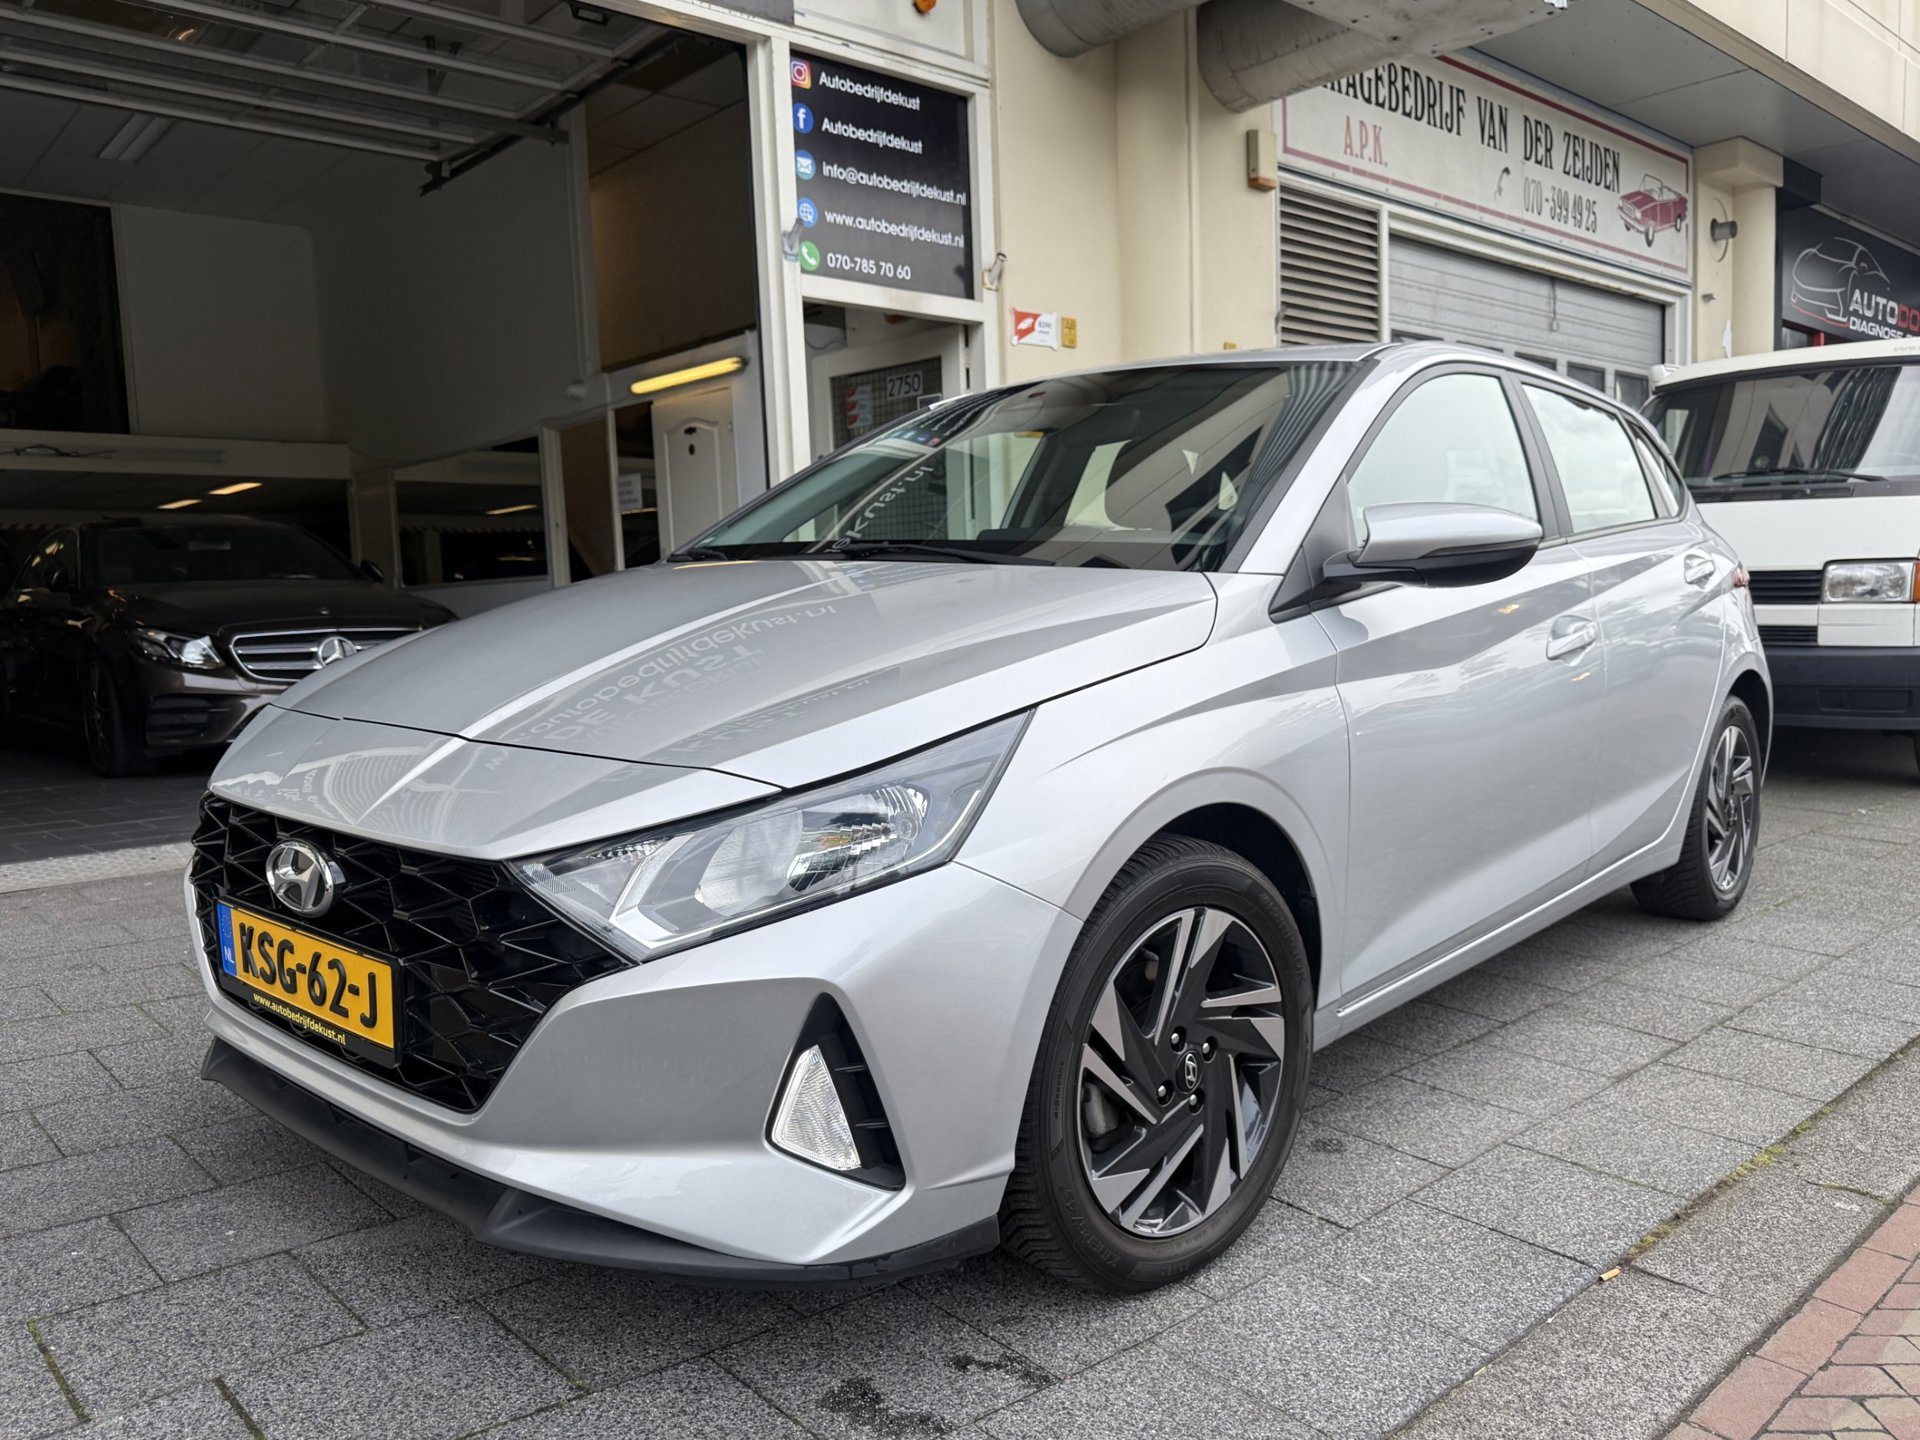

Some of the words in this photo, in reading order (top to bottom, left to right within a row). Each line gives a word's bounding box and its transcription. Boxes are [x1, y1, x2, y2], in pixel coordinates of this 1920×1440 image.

[818, 71, 920, 111] Autobedrijfdekust
[821, 117, 923, 154] Autobedrijfdekust
[1343, 115, 1388, 167] A.P.K.
[1477, 96, 1508, 154] VAN
[1523, 114, 1554, 170] DER
[1563, 131, 1620, 194] ZEIJDEN
[822, 161, 967, 206] info@autobedrijfdekust.nl
[824, 209, 965, 248] www.autobedrijfdekust.nl
[827, 252, 877, 275] 070-785
[879, 261, 895, 278] 70
[896, 264, 911, 280] 60
[1849, 289, 1920, 332] AUTODO
[888, 373, 921, 397] 2750
[224, 946, 235, 964] NL
[239, 922, 378, 1028] KSG-62-J
[253, 993, 346, 1045] www.autobedrijfdekust.nl
